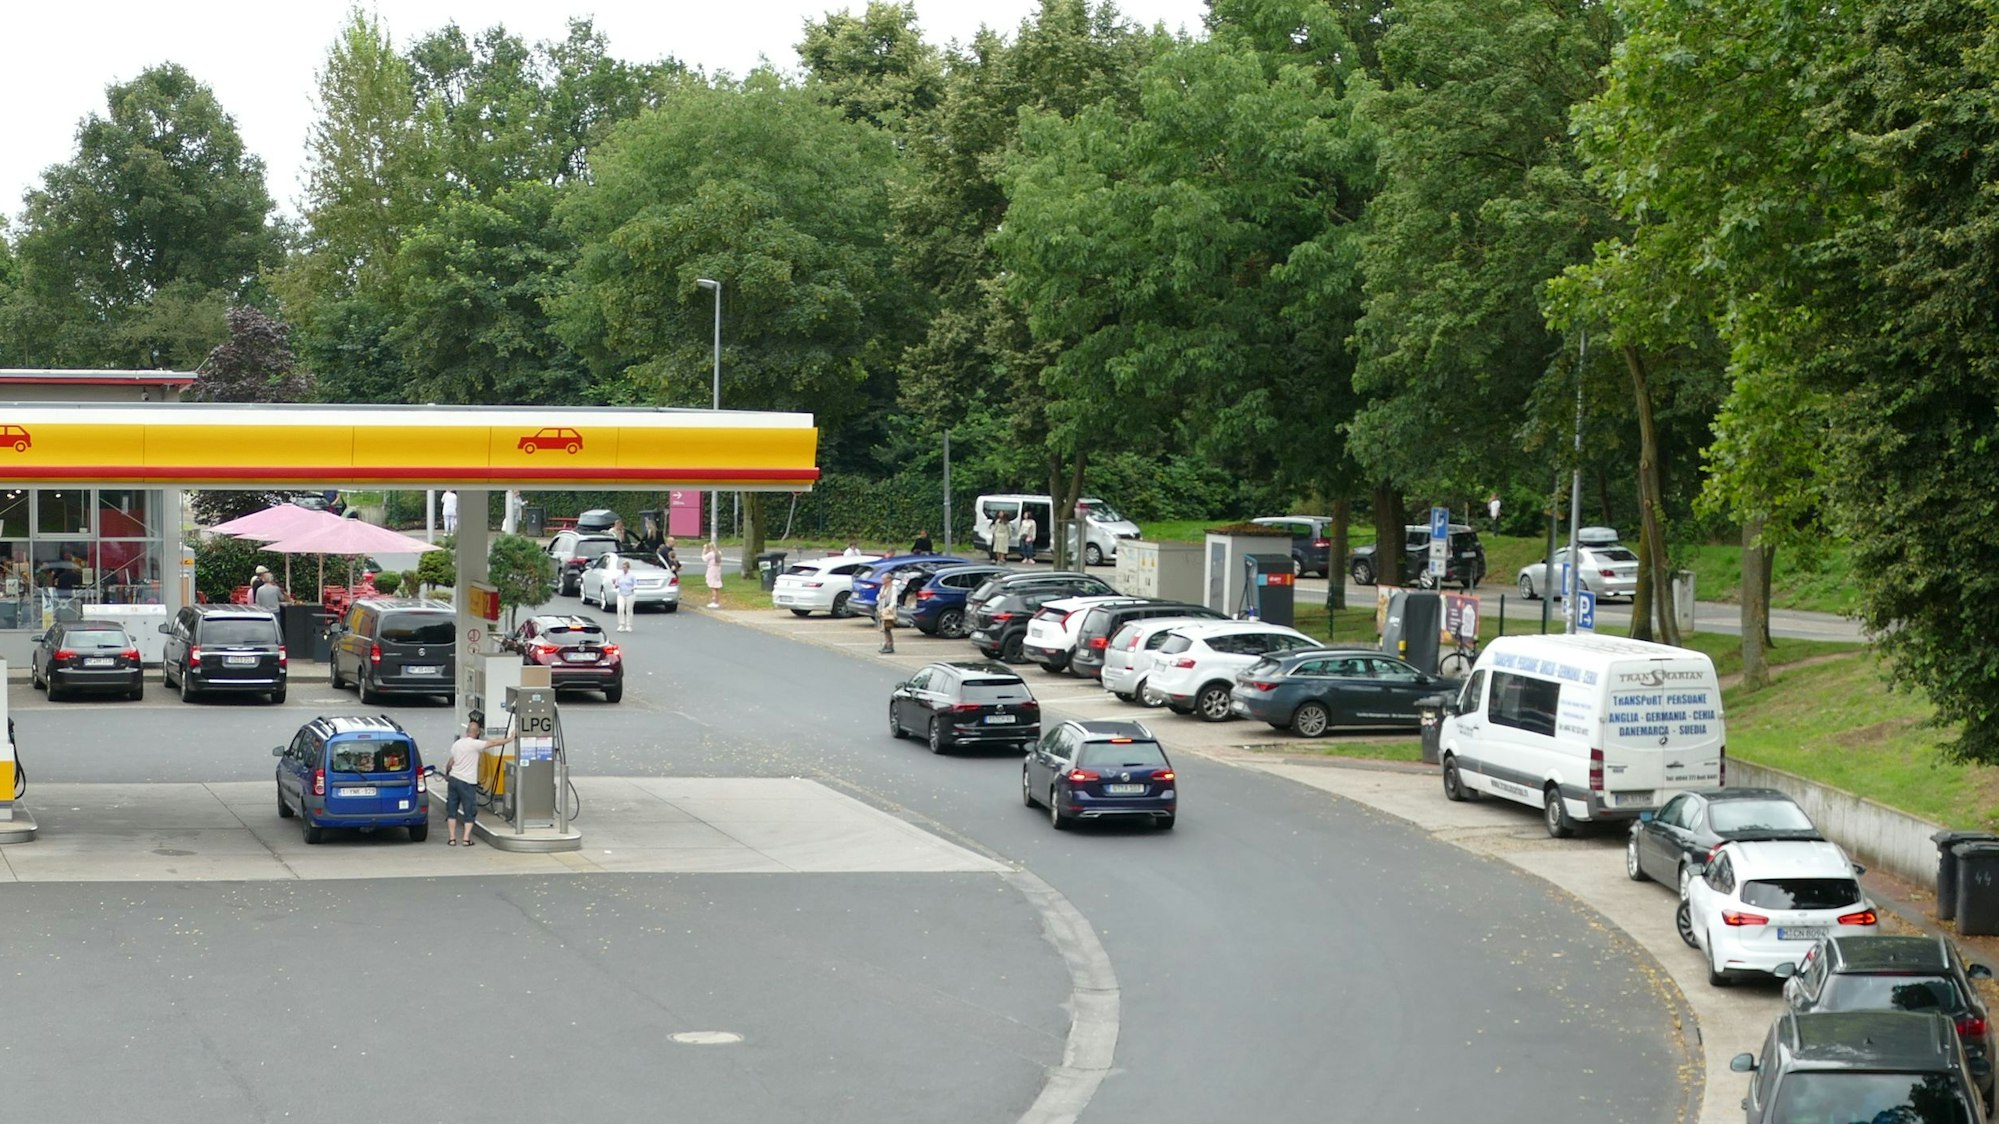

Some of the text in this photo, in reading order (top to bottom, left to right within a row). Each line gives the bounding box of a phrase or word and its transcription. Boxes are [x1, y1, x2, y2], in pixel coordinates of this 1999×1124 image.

[1433, 509, 1444, 536] P
[1579, 597, 1591, 627] P
[1667, 694, 1706, 704] PERSOANE
[1609, 712, 1639, 723] ANGLIA
[1645, 711, 1687, 722] GERMANIA
[1693, 710, 1715, 720] CEHIA
[521, 717, 552, 732] LPG
[1619, 725, 1669, 737] DANEMARCA
[1679, 724, 1707, 735] SUEDIA
[1975, 871, 1992, 886] 44
